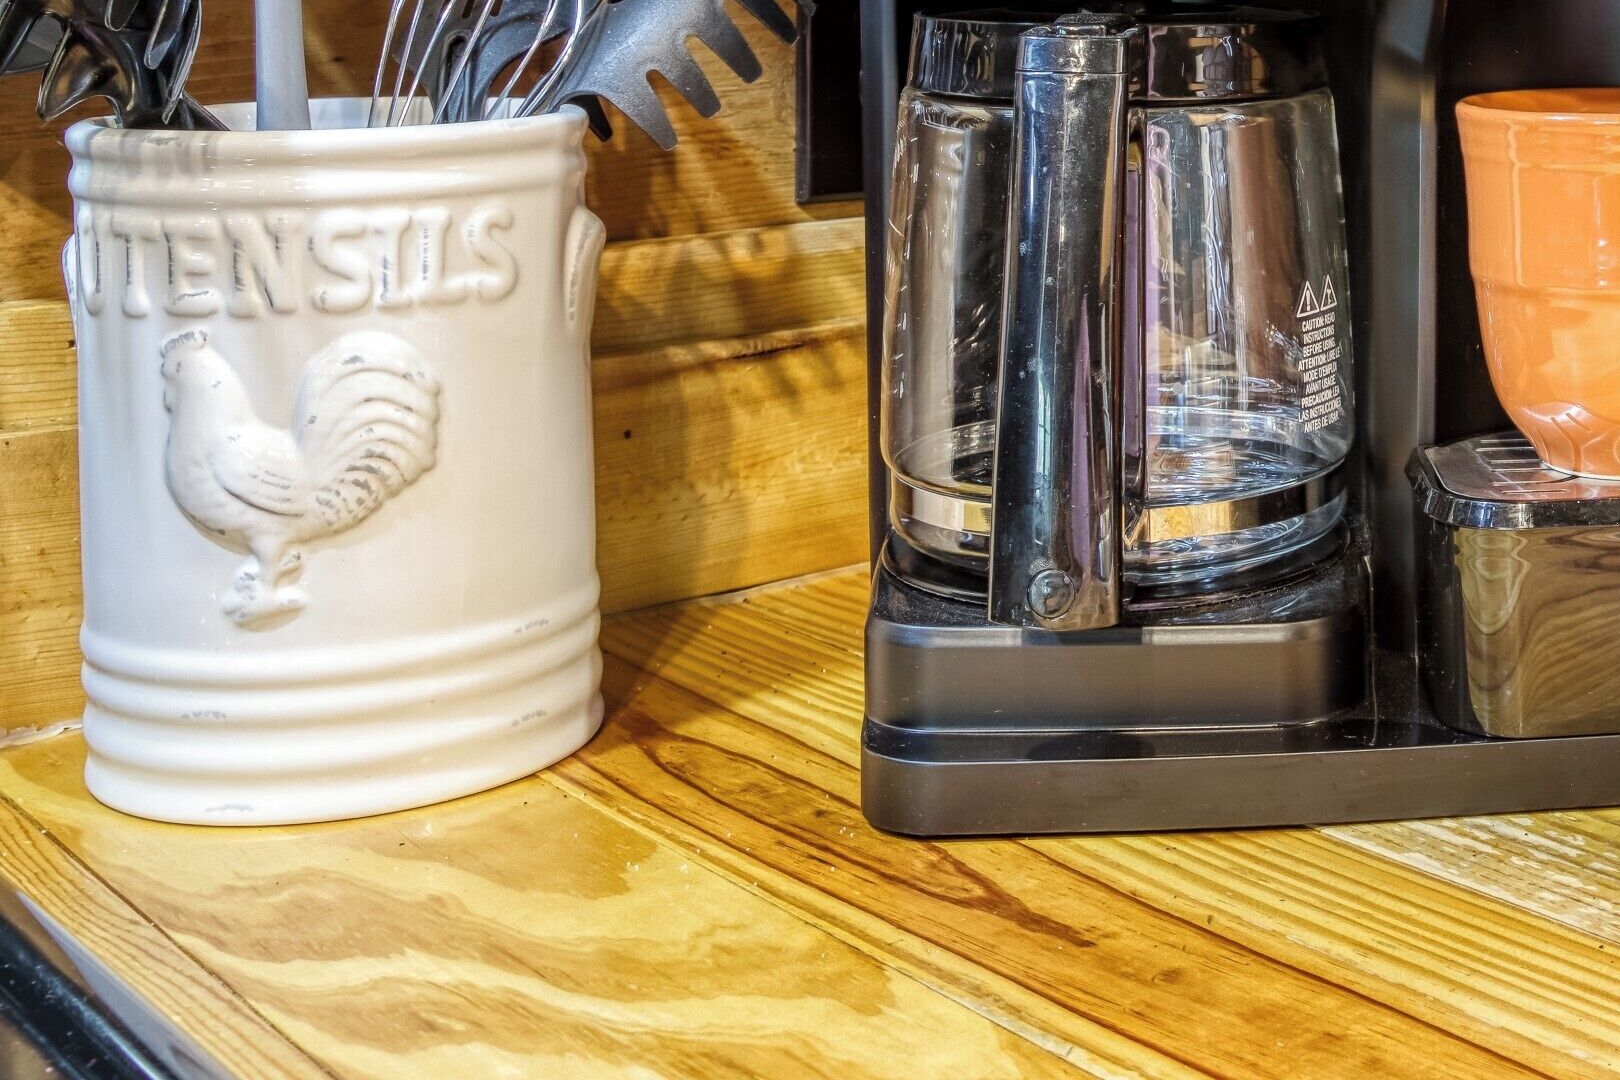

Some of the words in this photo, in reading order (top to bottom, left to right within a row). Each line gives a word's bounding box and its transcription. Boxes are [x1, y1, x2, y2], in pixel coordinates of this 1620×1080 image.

[76, 205, 519, 319] UTENSILS
[1301, 315, 1325, 332] CAUTION:
[1303, 324, 1335, 345] INSTRUCTIONS
[1303, 341, 1323, 358] BEFORE
[1303, 369, 1319, 383] MODE
[1306, 380, 1321, 395] AVANT
[1298, 409, 1310, 423] LAS
[1304, 418, 1321, 433] ANTES
[1321, 415, 1329, 428] DE
